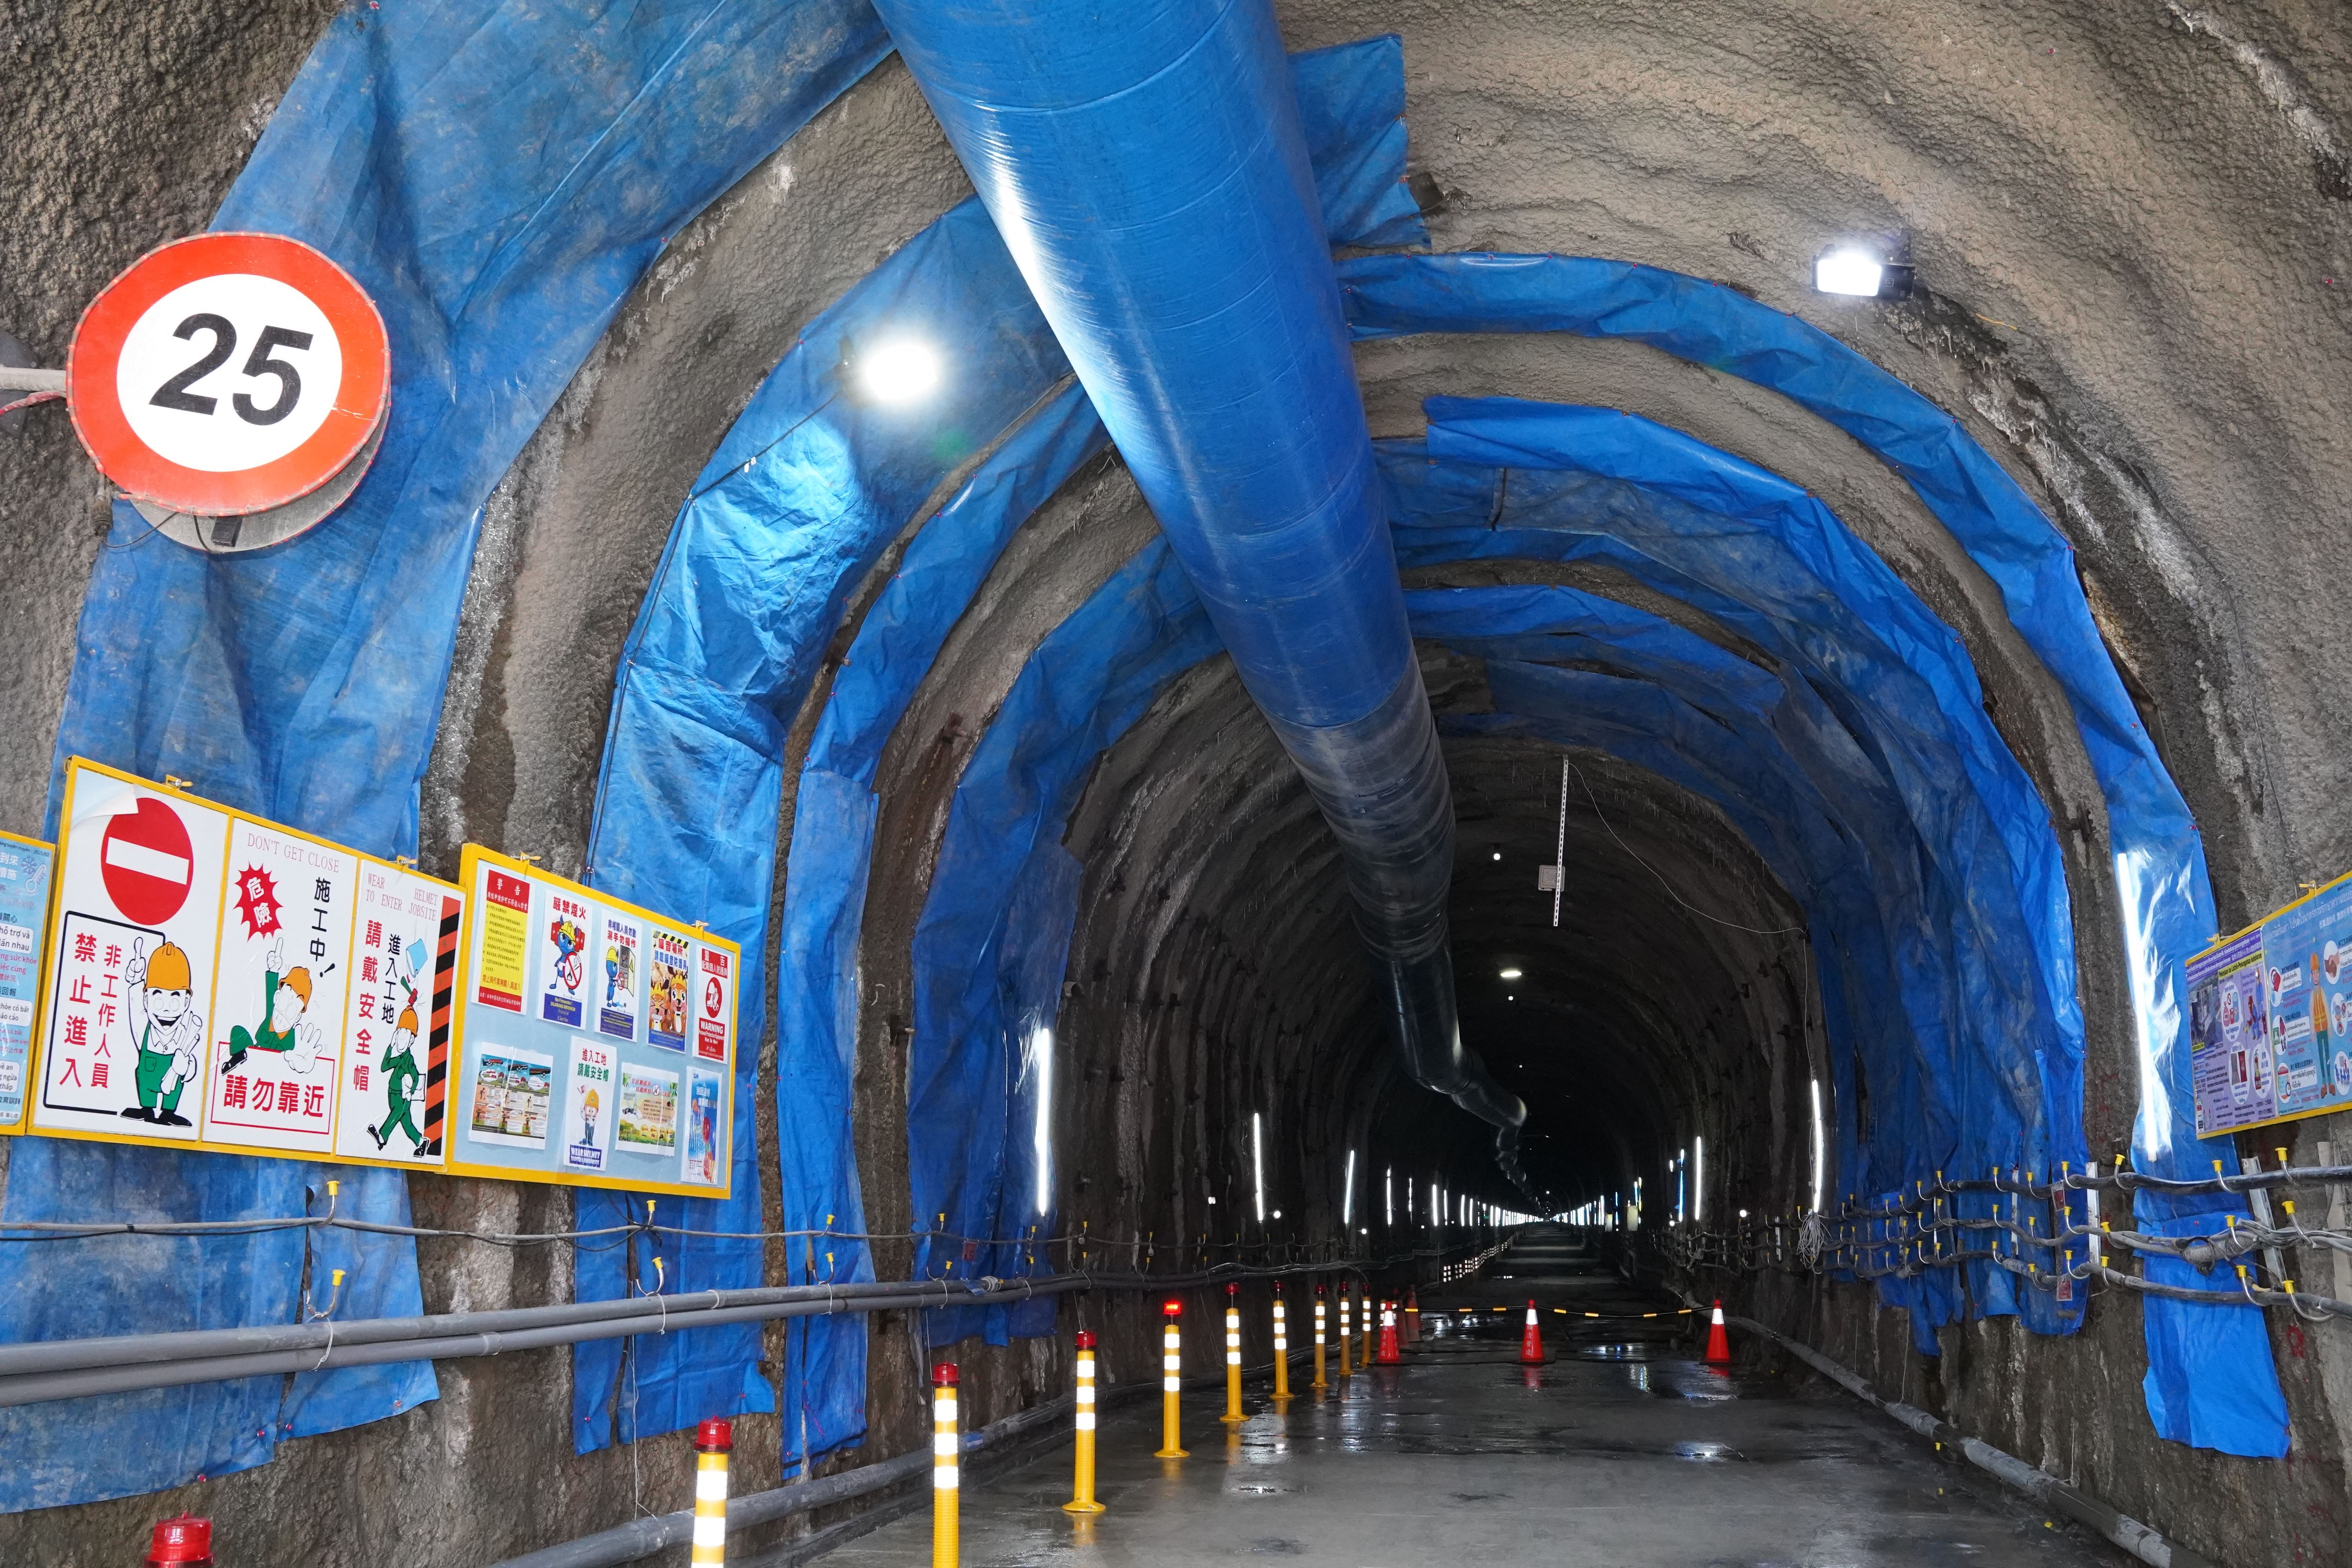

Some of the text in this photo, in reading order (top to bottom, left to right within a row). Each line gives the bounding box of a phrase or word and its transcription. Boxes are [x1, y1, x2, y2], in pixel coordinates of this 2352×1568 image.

[149, 313, 314, 426] 25
[247, 833, 339, 874] DON'T GET CLOSE
[247, 877, 272, 928] 危險
[366, 889, 436, 921] TO ENTER JOBSITE
[368, 873, 438, 906] WEAR HELMET
[553, 897, 586, 920] 嚴禁煙火
[12, 941, 29, 951] nhau
[22, 931, 30, 939] và
[11, 965, 26, 975] cùng
[381, 933, 401, 1025] 進入工地
[59, 932, 97, 1087] 禁止進入
[91, 944, 122, 1089] 非工作人員
[353, 920, 383, 1093] 請戴安全帽
[701, 1020, 723, 1034] WARNING
[577, 1062, 609, 1082] 請戴安全帽
[582, 1047, 606, 1065] 進入工地
[223, 1074, 325, 1119] 請勿靠近
